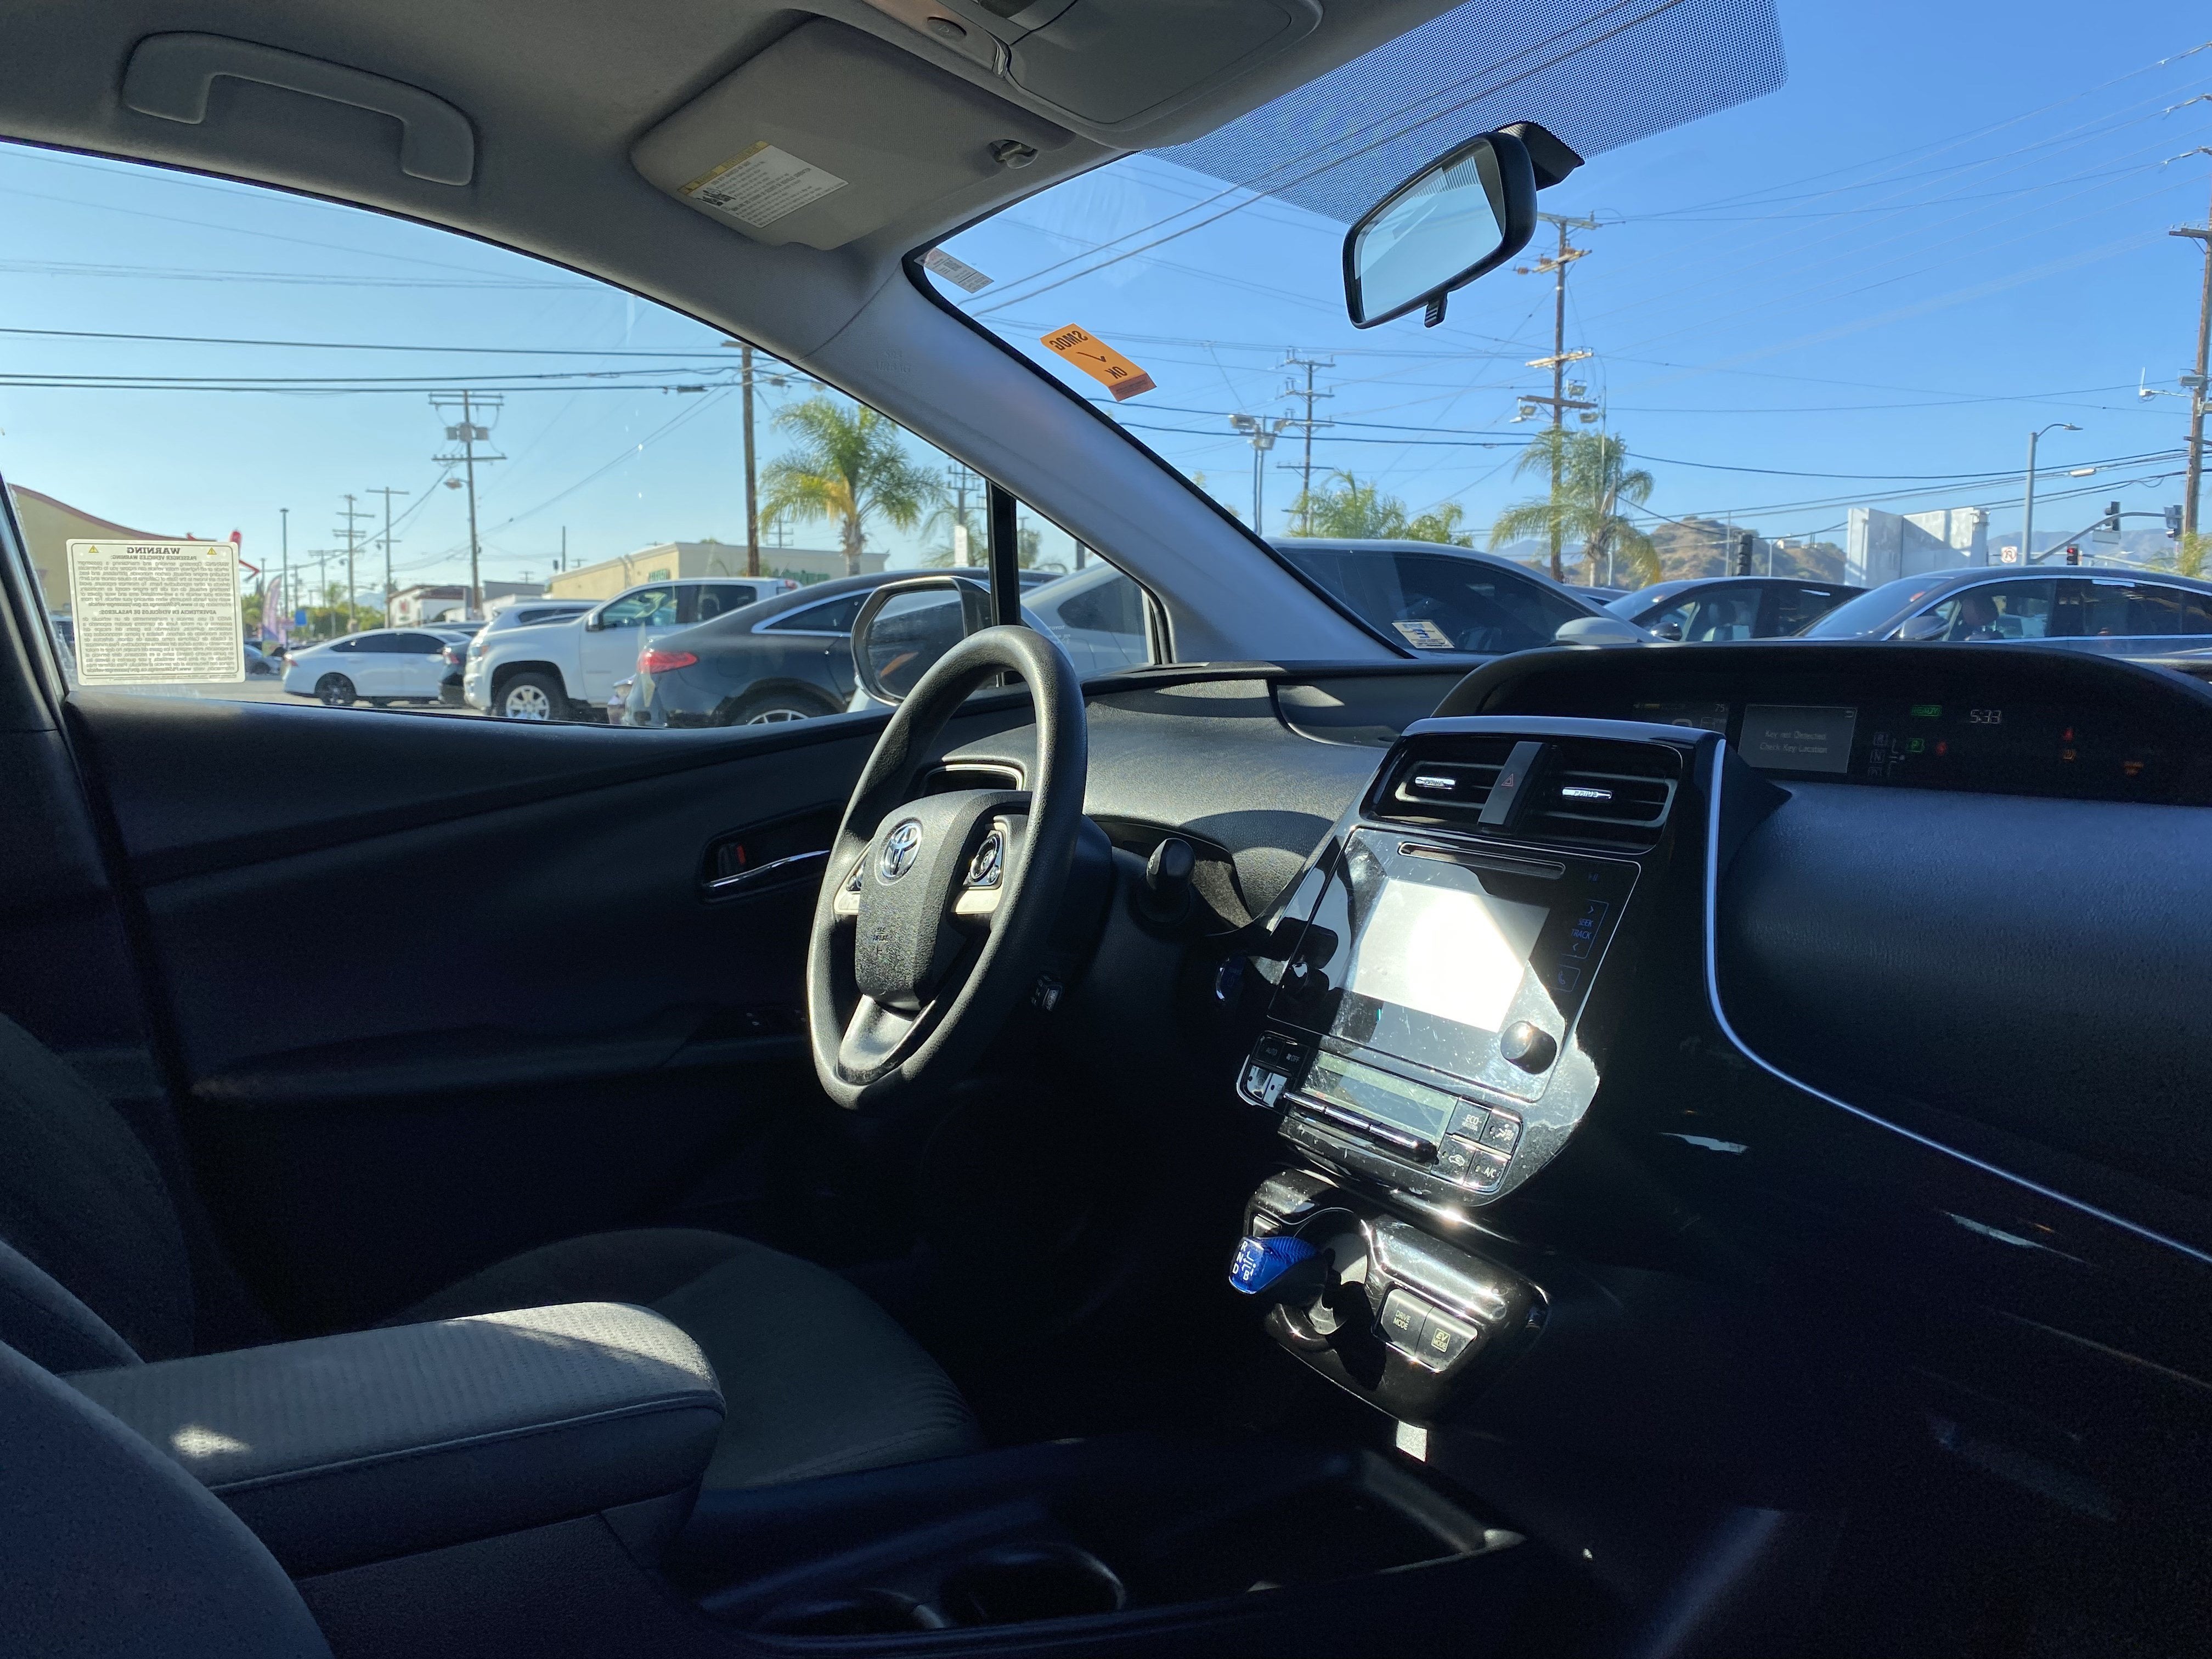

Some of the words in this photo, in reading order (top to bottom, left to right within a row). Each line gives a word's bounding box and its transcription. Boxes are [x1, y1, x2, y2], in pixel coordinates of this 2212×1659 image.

[1970, 709, 2002, 724] 5:33
[1578, 917, 1594, 928] SEEK
[1571, 928, 1592, 940] TRACK
[1265, 1047, 1278, 1056] AUTO
[1465, 1114, 1480, 1125] ECO
[1483, 1166, 1497, 1178] A/C
[1240, 1240, 1248, 1252] R
[1236, 1251, 1244, 1263] N
[1232, 1262, 1239, 1274] D
[1243, 1269, 1250, 1281] B
[1395, 1310, 1411, 1324] DRIVE
[1392, 1317, 1409, 1331] MODE
[1435, 1331, 1449, 1342] EV
[1433, 1339, 1448, 1350] MODE
